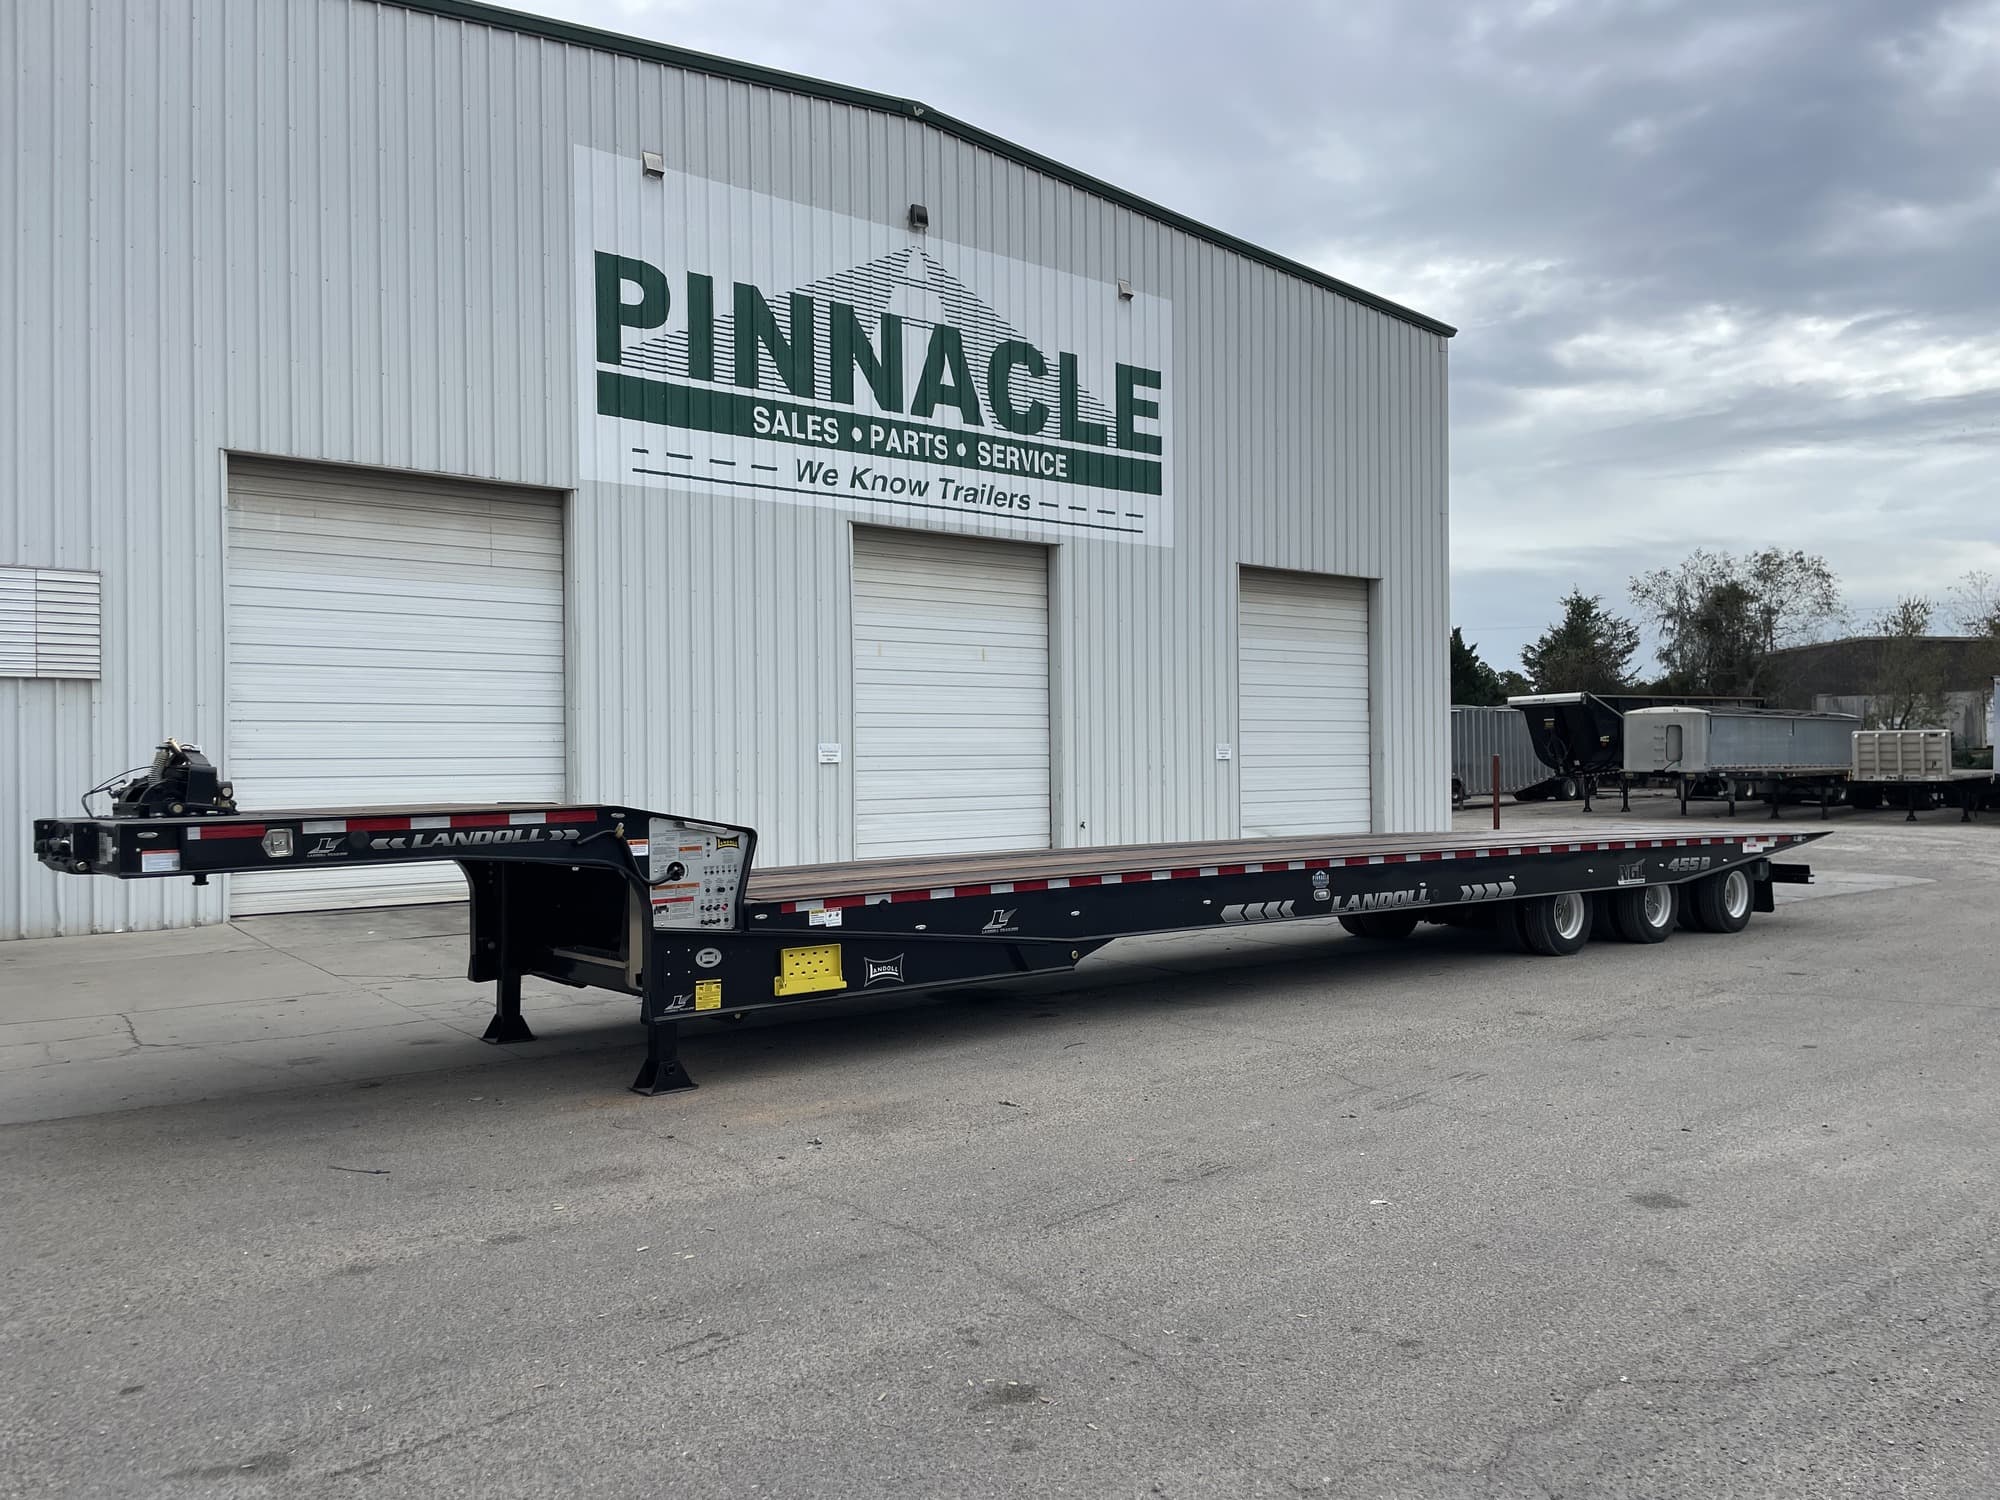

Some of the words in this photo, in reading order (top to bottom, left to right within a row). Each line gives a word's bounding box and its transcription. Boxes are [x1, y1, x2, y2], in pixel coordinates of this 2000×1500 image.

[594, 249, 1162, 456] PINNACLE
[753, 406, 839, 444] SALES
[870, 425, 948, 459] PARTS
[977, 441, 1068, 478] SERVICE
[796, 458, 839, 486] We
[850, 466, 930, 497] Know
[938, 477, 1031, 511] Trailers
[411, 828, 546, 849] LANDOLL
[1331, 888, 1431, 912] LANDOLL
[870, 963, 899, 979] LANDOLL
